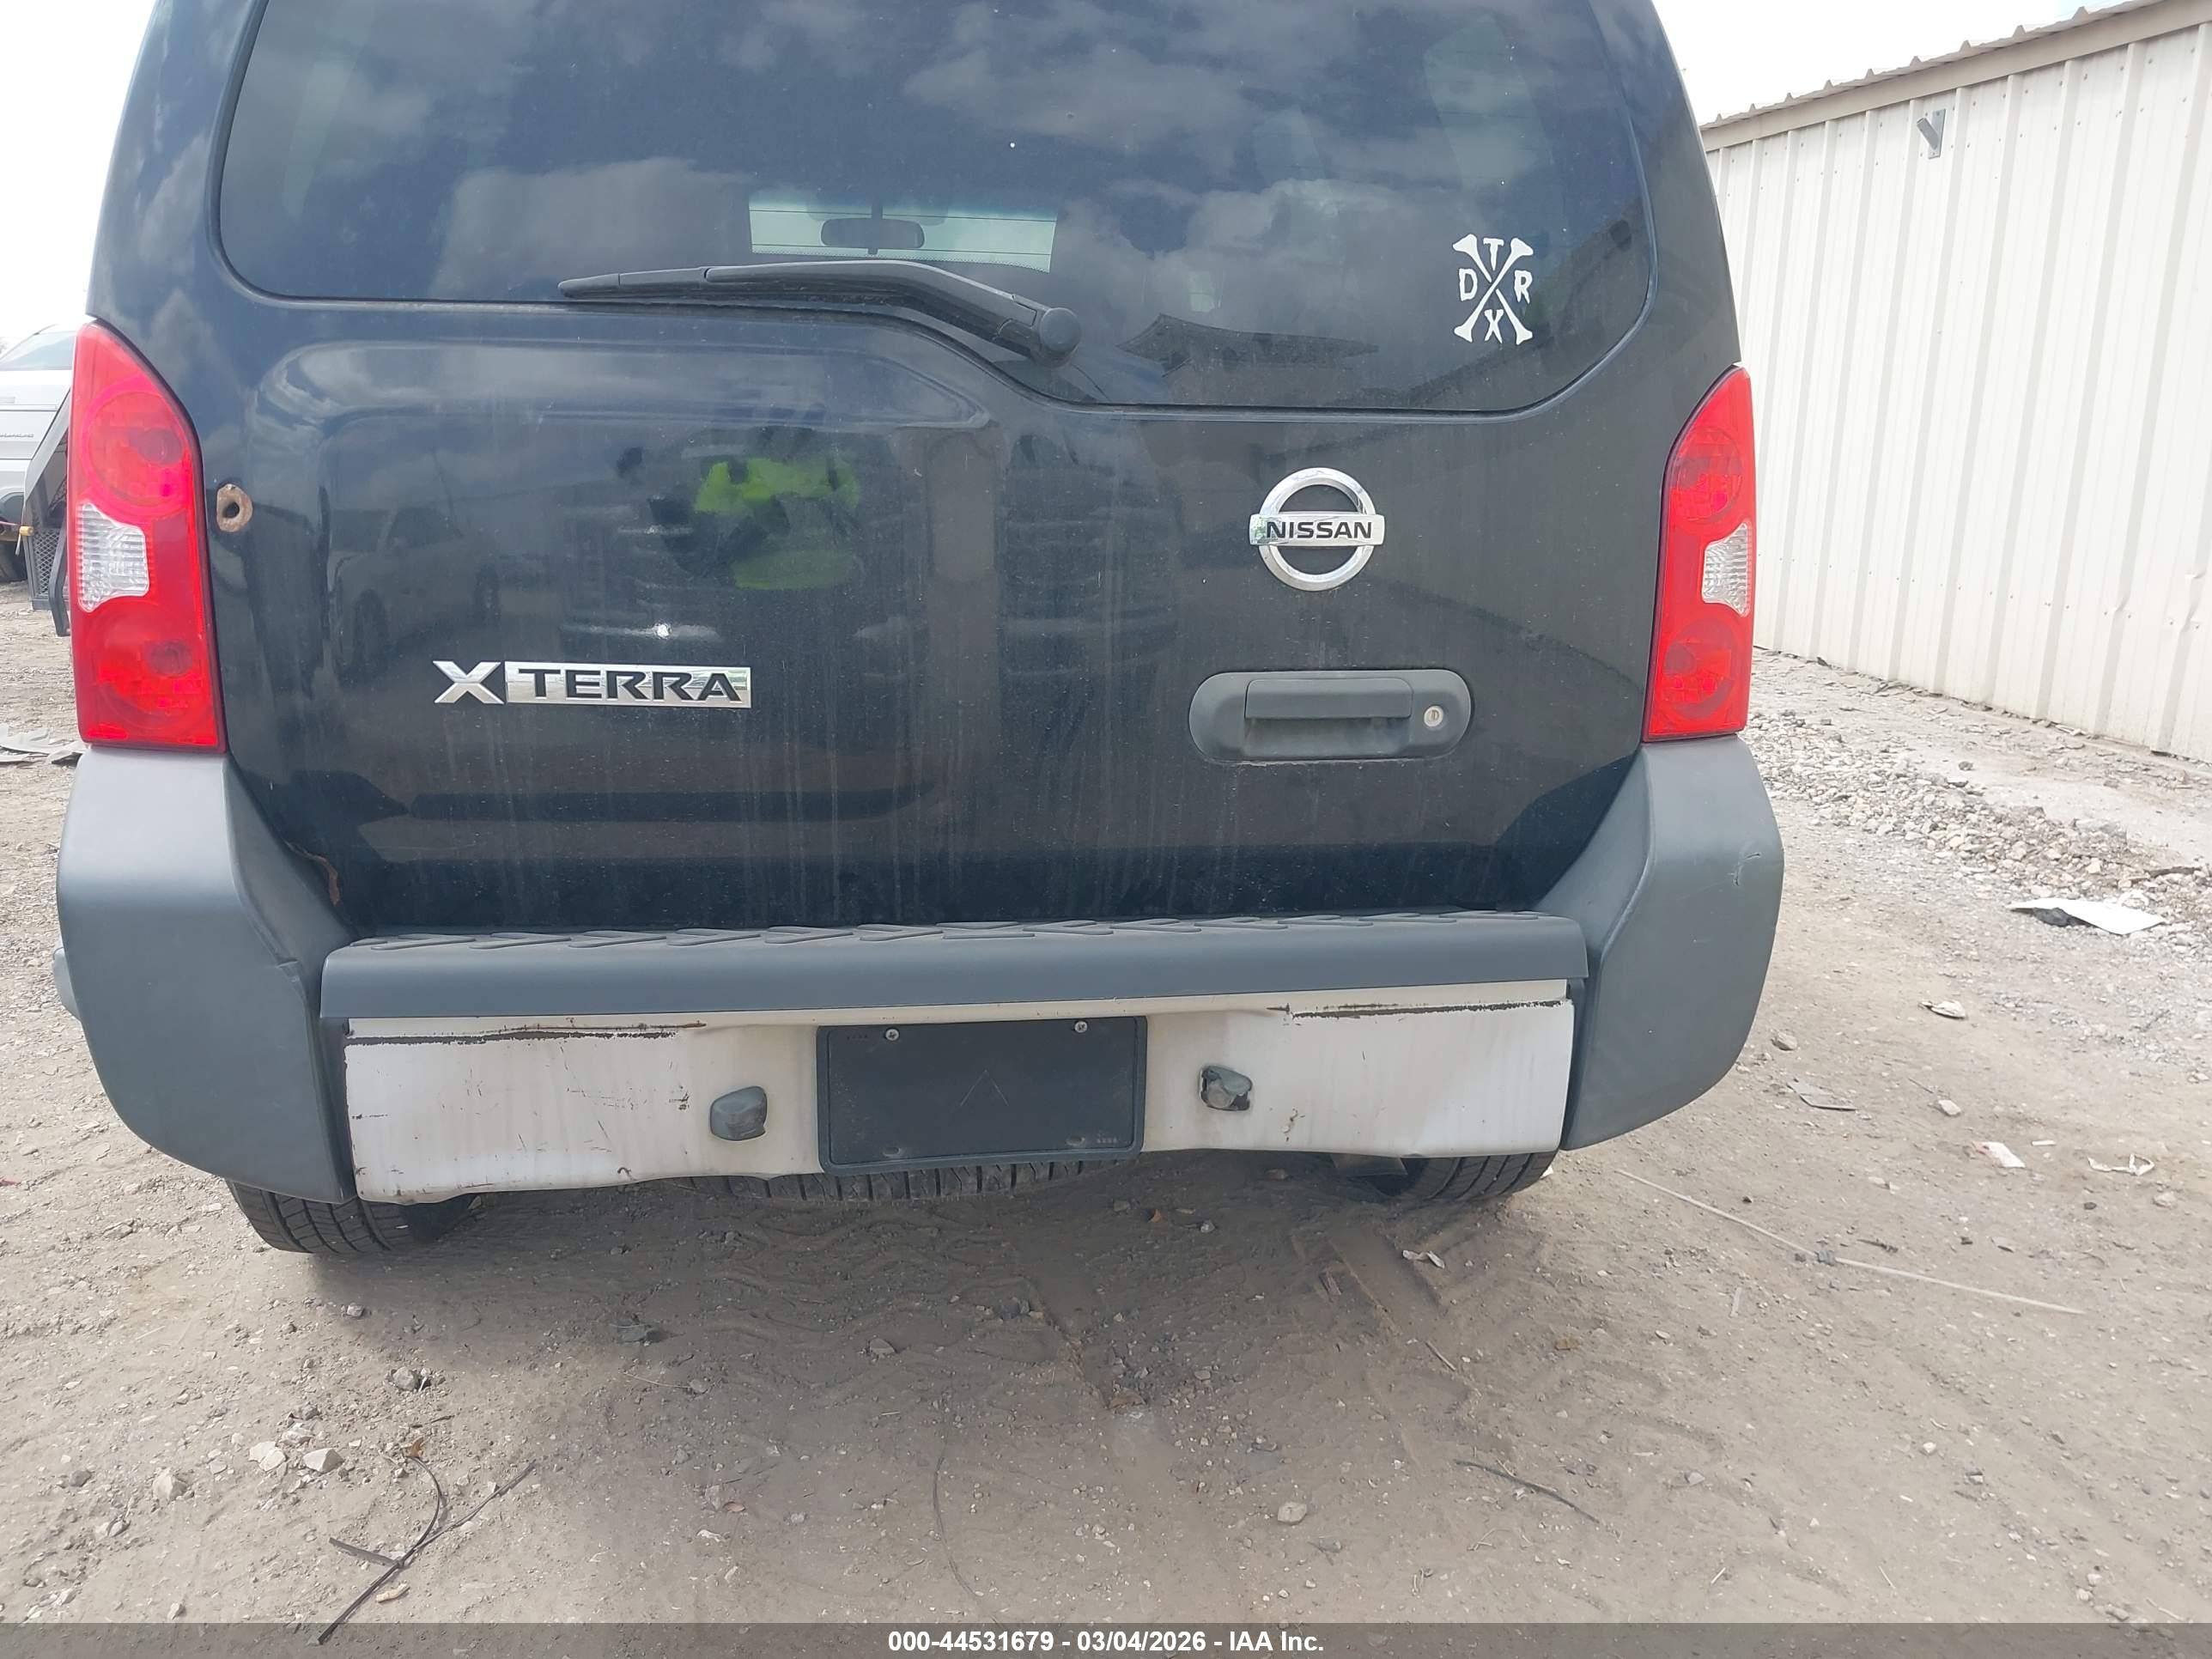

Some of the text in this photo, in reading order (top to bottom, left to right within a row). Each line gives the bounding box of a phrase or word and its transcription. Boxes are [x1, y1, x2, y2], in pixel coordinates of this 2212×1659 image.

[1483, 237, 1504, 271] T
[1458, 268, 1533, 304] D R
[1266, 521, 1372, 539] NISSAN
